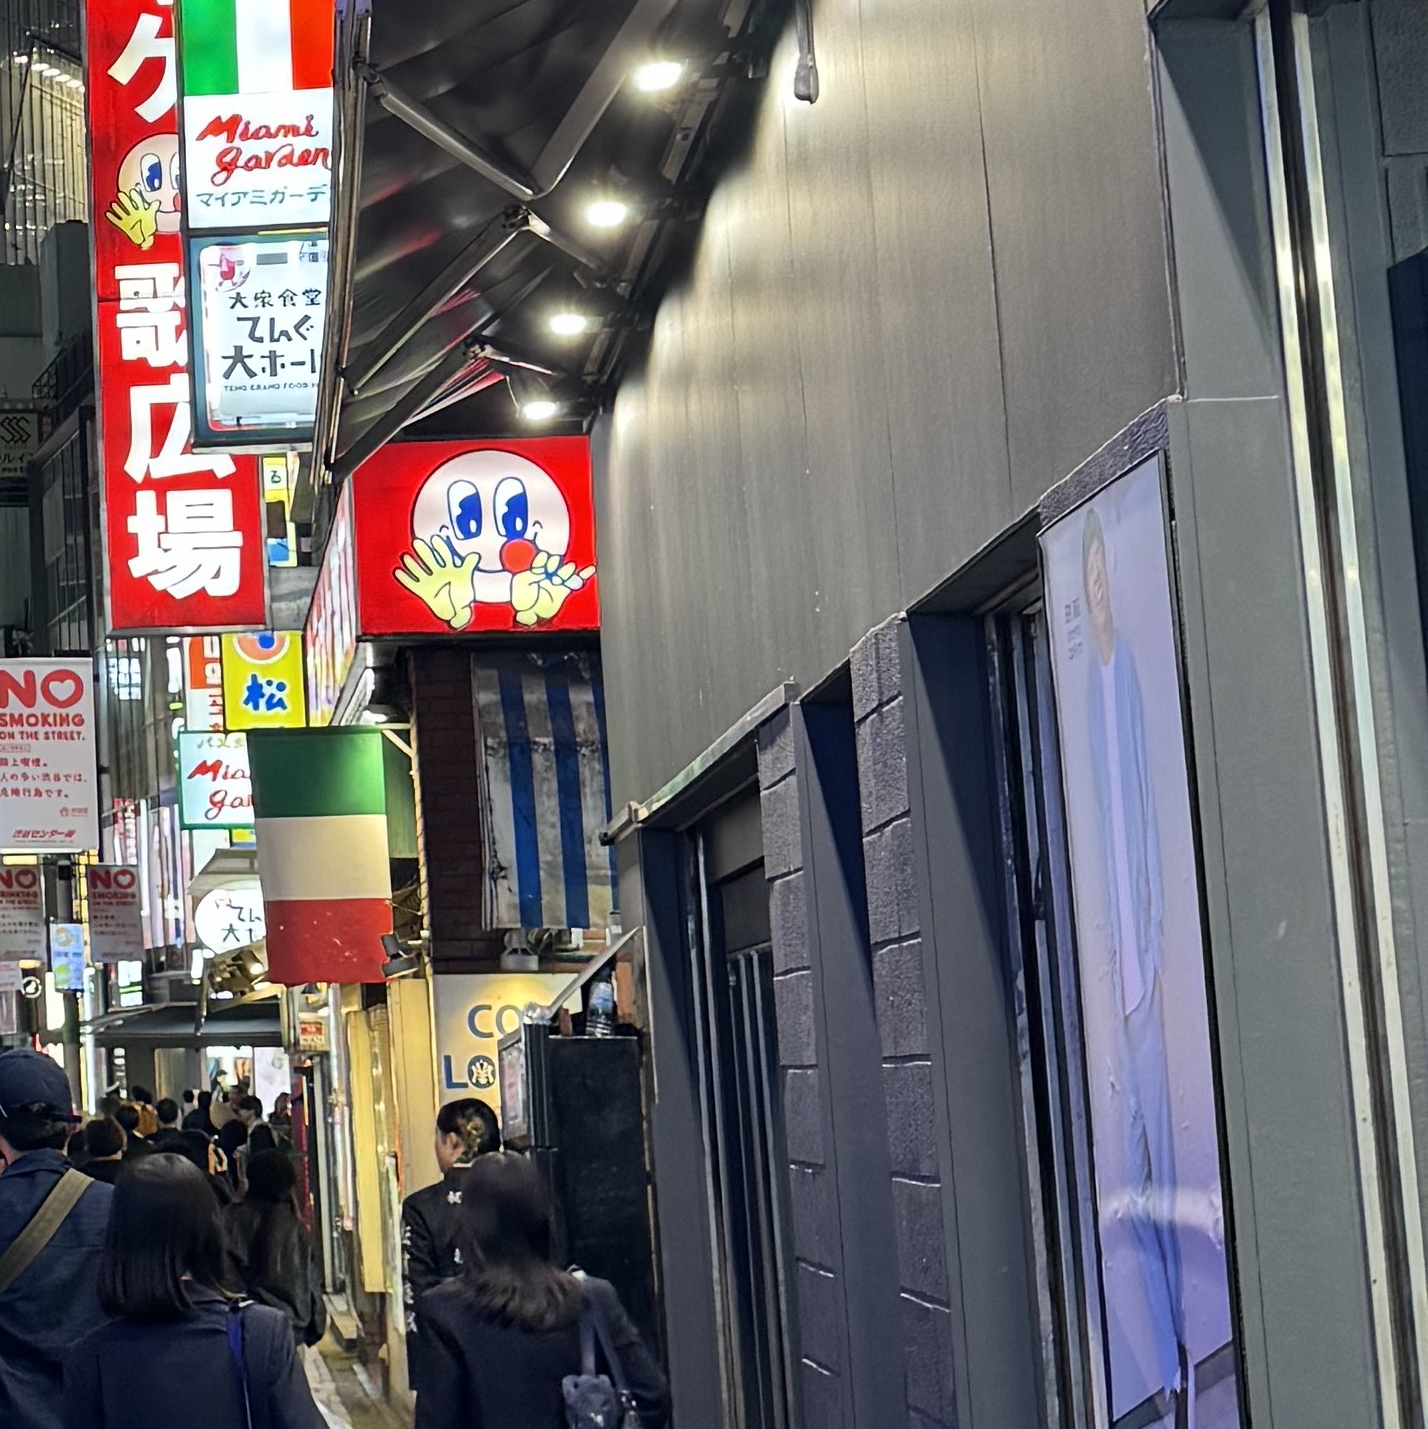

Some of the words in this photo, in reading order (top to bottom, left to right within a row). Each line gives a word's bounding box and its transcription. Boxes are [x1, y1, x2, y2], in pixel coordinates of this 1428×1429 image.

[195, 112, 320, 144] Miami
[228, 287, 322, 310] 大衆食堂
[236, 314, 315, 343] てんぐ
[244, 673, 288, 712] 松
[19, 730, 39, 741] THE
[43, 730, 86, 741] STREET.
[90, 869, 136, 889] NO
